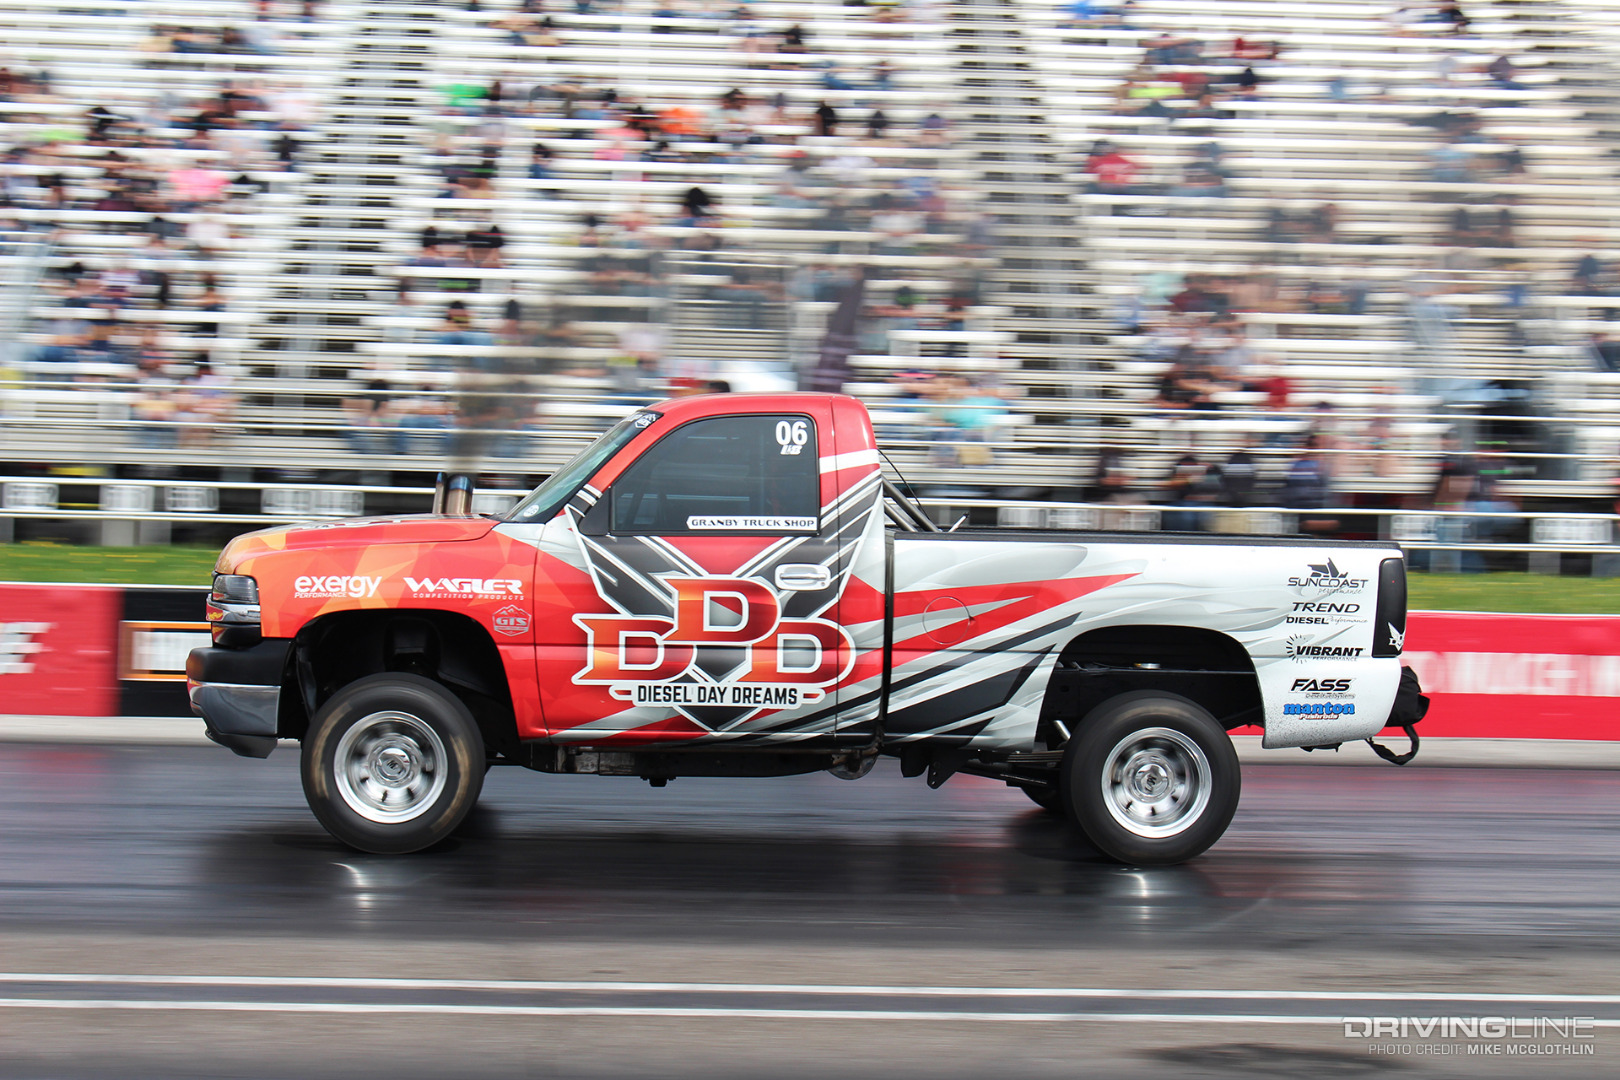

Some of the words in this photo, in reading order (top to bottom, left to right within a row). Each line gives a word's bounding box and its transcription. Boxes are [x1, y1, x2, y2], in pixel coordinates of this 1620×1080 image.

[775, 420, 808, 446] 06
[691, 518, 738, 527] GRANBY
[743, 518, 781, 527] TRUCK
[784, 519, 815, 527] SHOP
[294, 575, 382, 598] exergy
[403, 577, 523, 595] WAGLER
[1287, 577, 1369, 589] SUNCOAST
[1292, 602, 1361, 614] TREND
[496, 616, 527, 626] GTS
[1286, 616, 1330, 625] DIESEL
[1296, 645, 1364, 657] VIBRANT
[1290, 679, 1353, 692] FASS
[637, 685, 692, 703] DIESEL
[697, 686, 728, 704] DAY
[732, 687, 798, 705] DREAMS
[1283, 701, 1356, 715] manton
